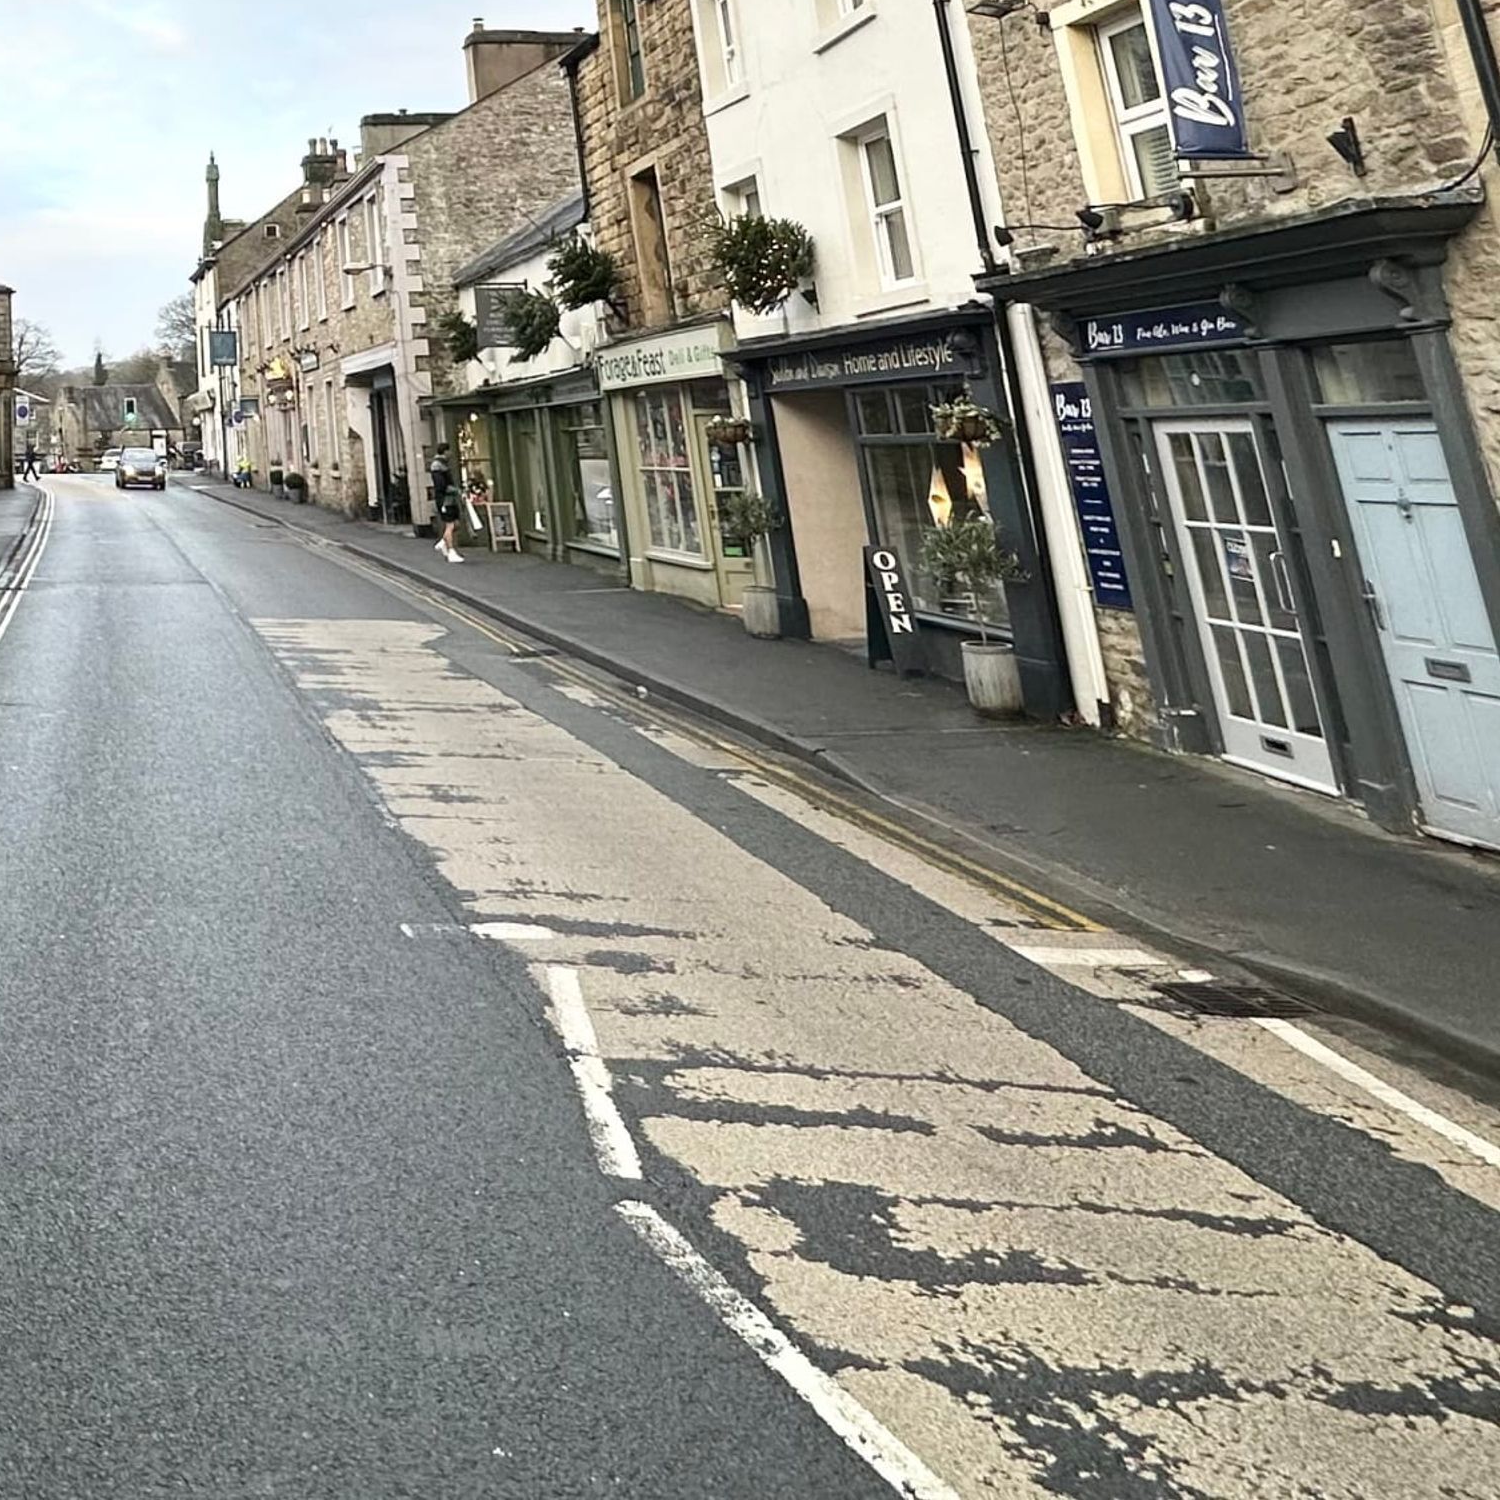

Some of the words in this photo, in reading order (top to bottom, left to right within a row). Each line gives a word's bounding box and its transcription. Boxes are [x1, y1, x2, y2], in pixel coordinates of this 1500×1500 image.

[1169, 1, 1215, 37] 13
[1170, 45, 1236, 128] Bar
[1088, 321, 1111, 349] Bar
[843, 352, 878, 375] Home
[879, 347, 899, 371] and
[901, 339, 953, 372] Lifestyle
[1055, 393, 1080, 420] Bar
[872, 550, 914, 634] OPEN
